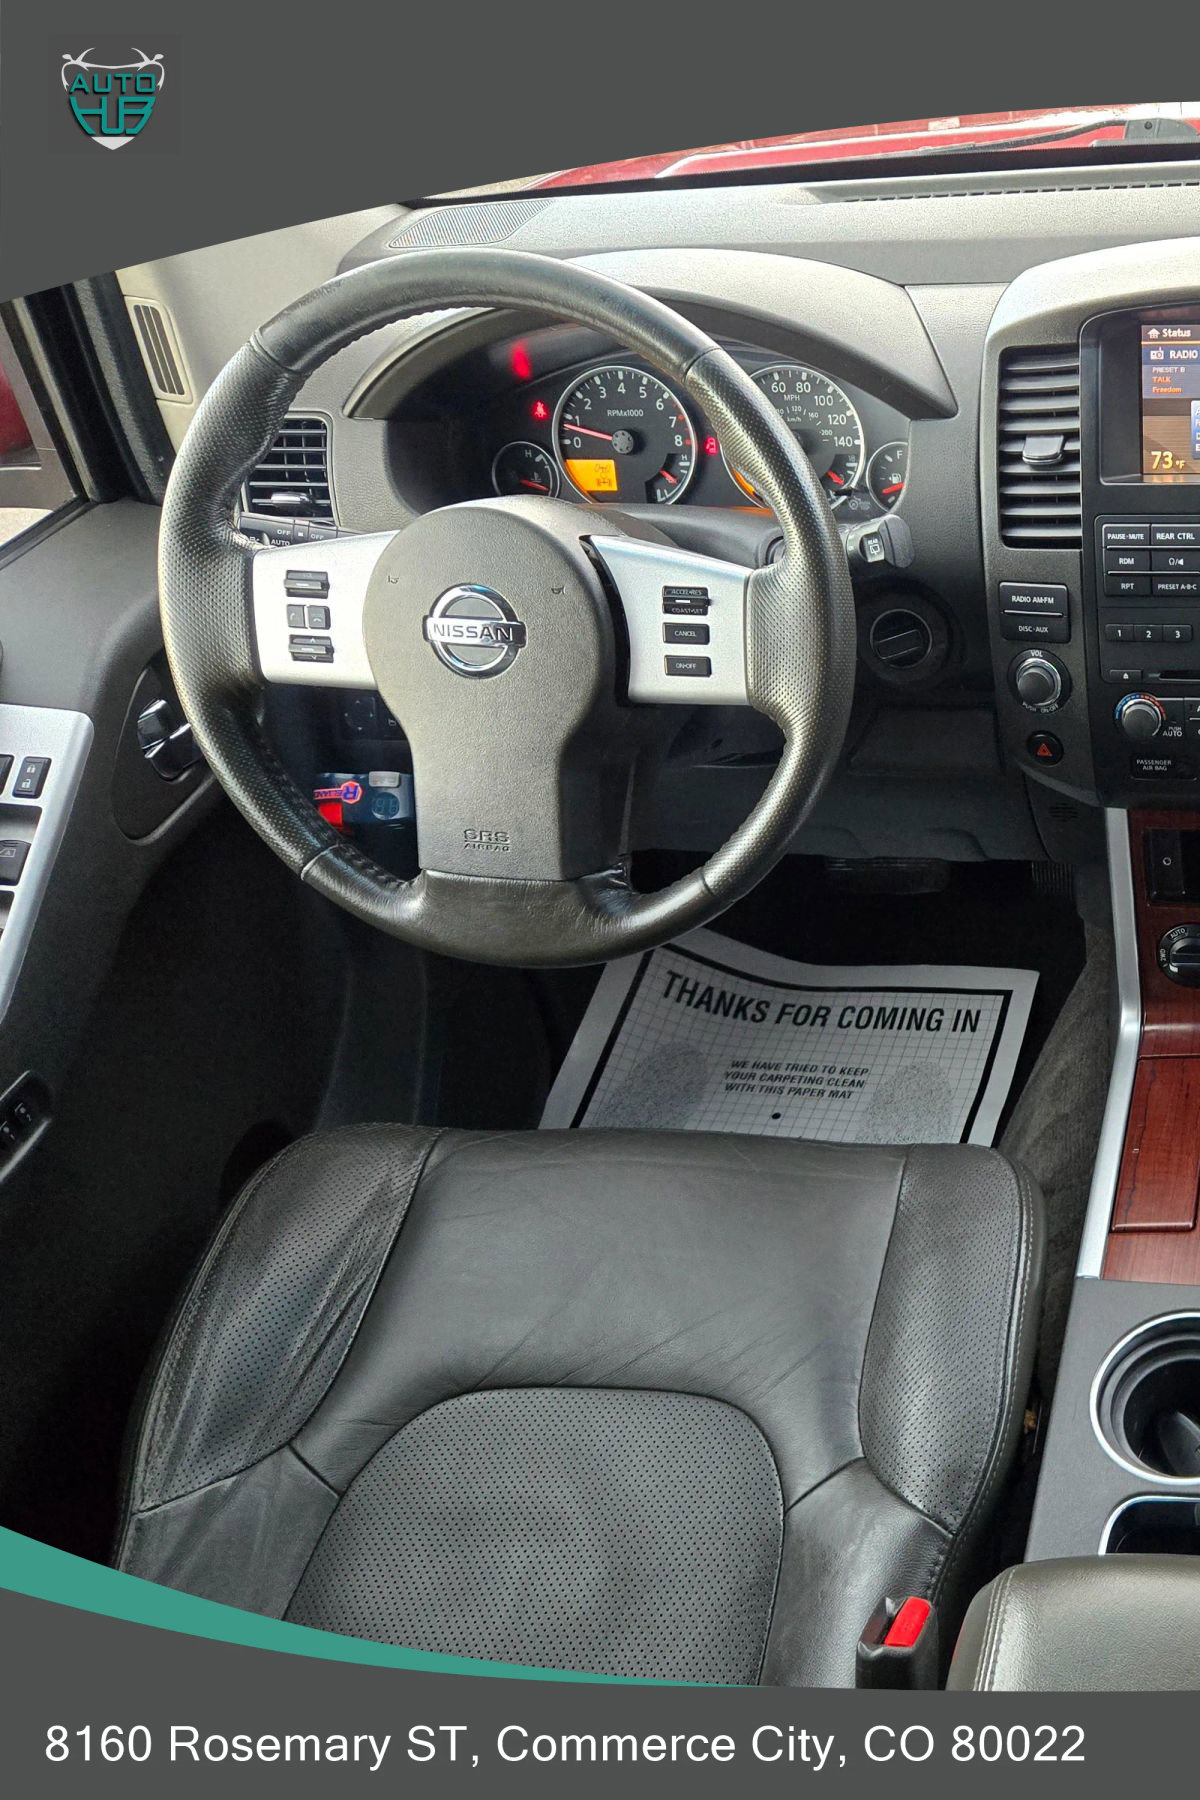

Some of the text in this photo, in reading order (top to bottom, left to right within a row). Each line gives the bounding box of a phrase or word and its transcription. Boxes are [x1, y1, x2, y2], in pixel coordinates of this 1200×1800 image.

[1162, 328, 1191, 338] Status
[1169, 349, 1199, 359] RADIO
[1152, 376, 1171, 384] TALK
[599, 387, 607, 398] 3
[617, 383, 626, 394] 4
[639, 387, 647, 398] 5
[771, 381, 786, 393] 60
[796, 381, 811, 393] 80
[584, 399, 592, 410] 2
[656, 399, 664, 411] 6
[814, 395, 834, 406] 100
[574, 416, 581, 426] 1
[669, 417, 677, 428] 7
[827, 414, 847, 425] 120
[573, 437, 582, 448] 0
[674, 435, 682, 446] 8
[834, 436, 853, 447] 140
[897, 450, 903, 459] F
[1151, 450, 1173, 469] 73
[1119, 557, 1135, 565] RDM
[1011, 595, 1031, 603] RADIO
[433, 622, 514, 642] NISSAN
[1146, 630, 1152, 638] 2
[1175, 630, 1181, 638] 3
[1030, 650, 1043, 658] VOL
[1022, 702, 1037, 712] PUSH
[463, 828, 511, 843] SRS
[1170, 928, 1186, 938] AUTO
[663, 970, 981, 1032] THANKS FOR COMING IN
[731, 1060, 869, 1077] WE HAVE TRIED TO KEEP
[725, 1071, 865, 1088] YOUR CARPETING CLEAN
[725, 1083, 855, 1099] WITH THIS PAPER MAT
